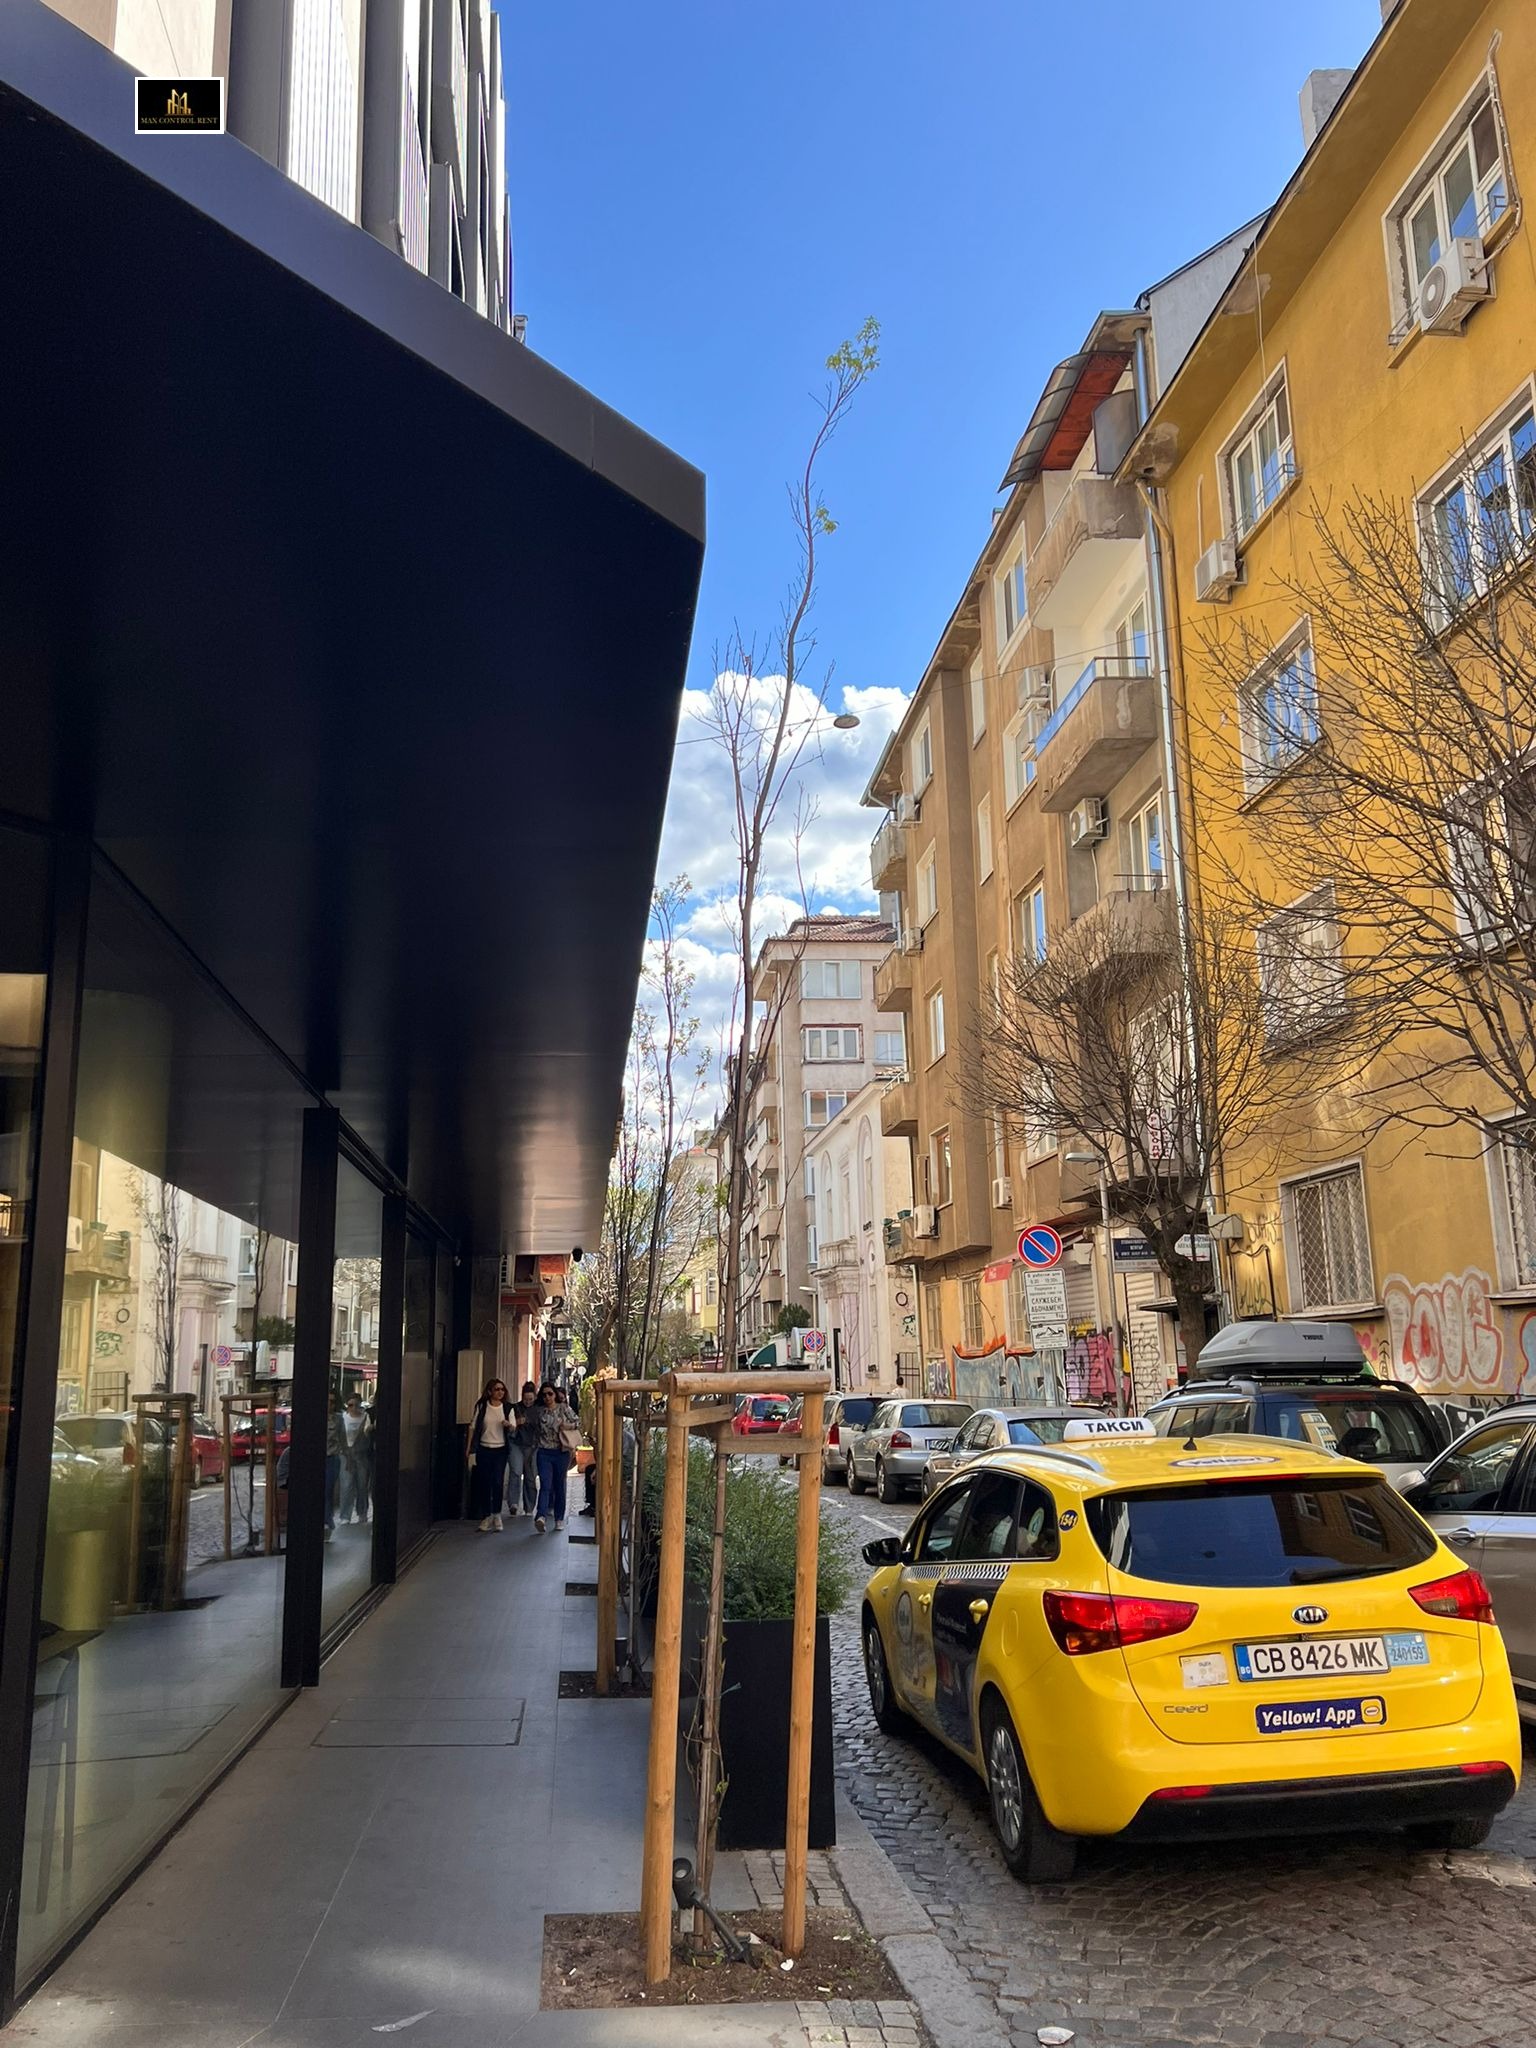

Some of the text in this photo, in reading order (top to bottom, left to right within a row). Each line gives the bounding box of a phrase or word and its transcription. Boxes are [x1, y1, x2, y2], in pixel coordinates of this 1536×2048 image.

[1084, 1421, 1144, 1434] ТАКСИ
[1060, 1513, 1078, 1526] 1541
[1298, 1608, 1324, 1621] KIA
[1254, 1641, 1384, 1673] CB 8426 MK
[1391, 1646, 1424, 1661] 240159
[1241, 1666, 1251, 1674] BG
[1262, 1708, 1356, 1727] Yellow! App
